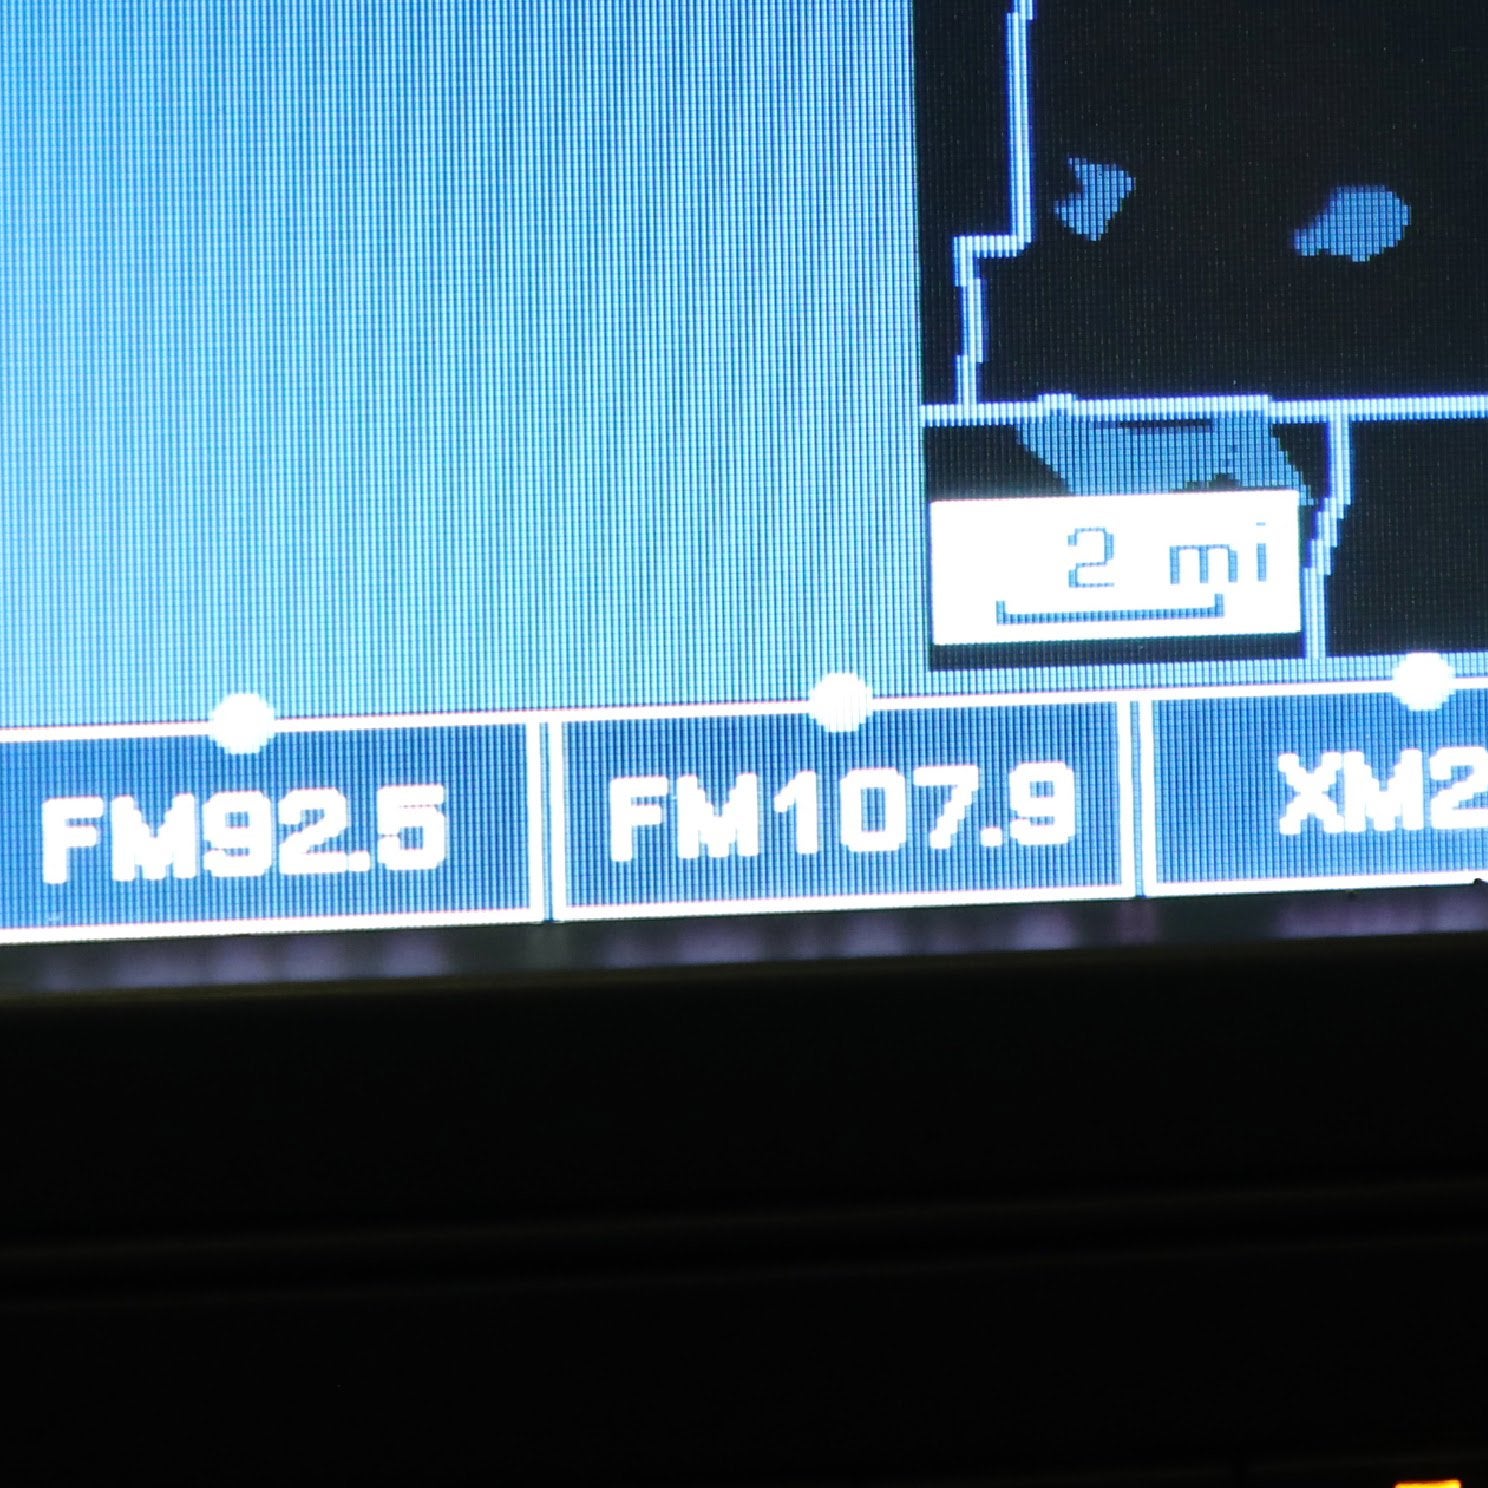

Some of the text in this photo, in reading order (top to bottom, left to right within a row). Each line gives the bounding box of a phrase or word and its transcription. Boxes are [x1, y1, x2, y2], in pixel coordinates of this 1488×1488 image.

[1068, 522, 1268, 589] 2 mi
[43, 784, 447, 883] FM92.5
[611, 761, 1075, 862] FM107.9
